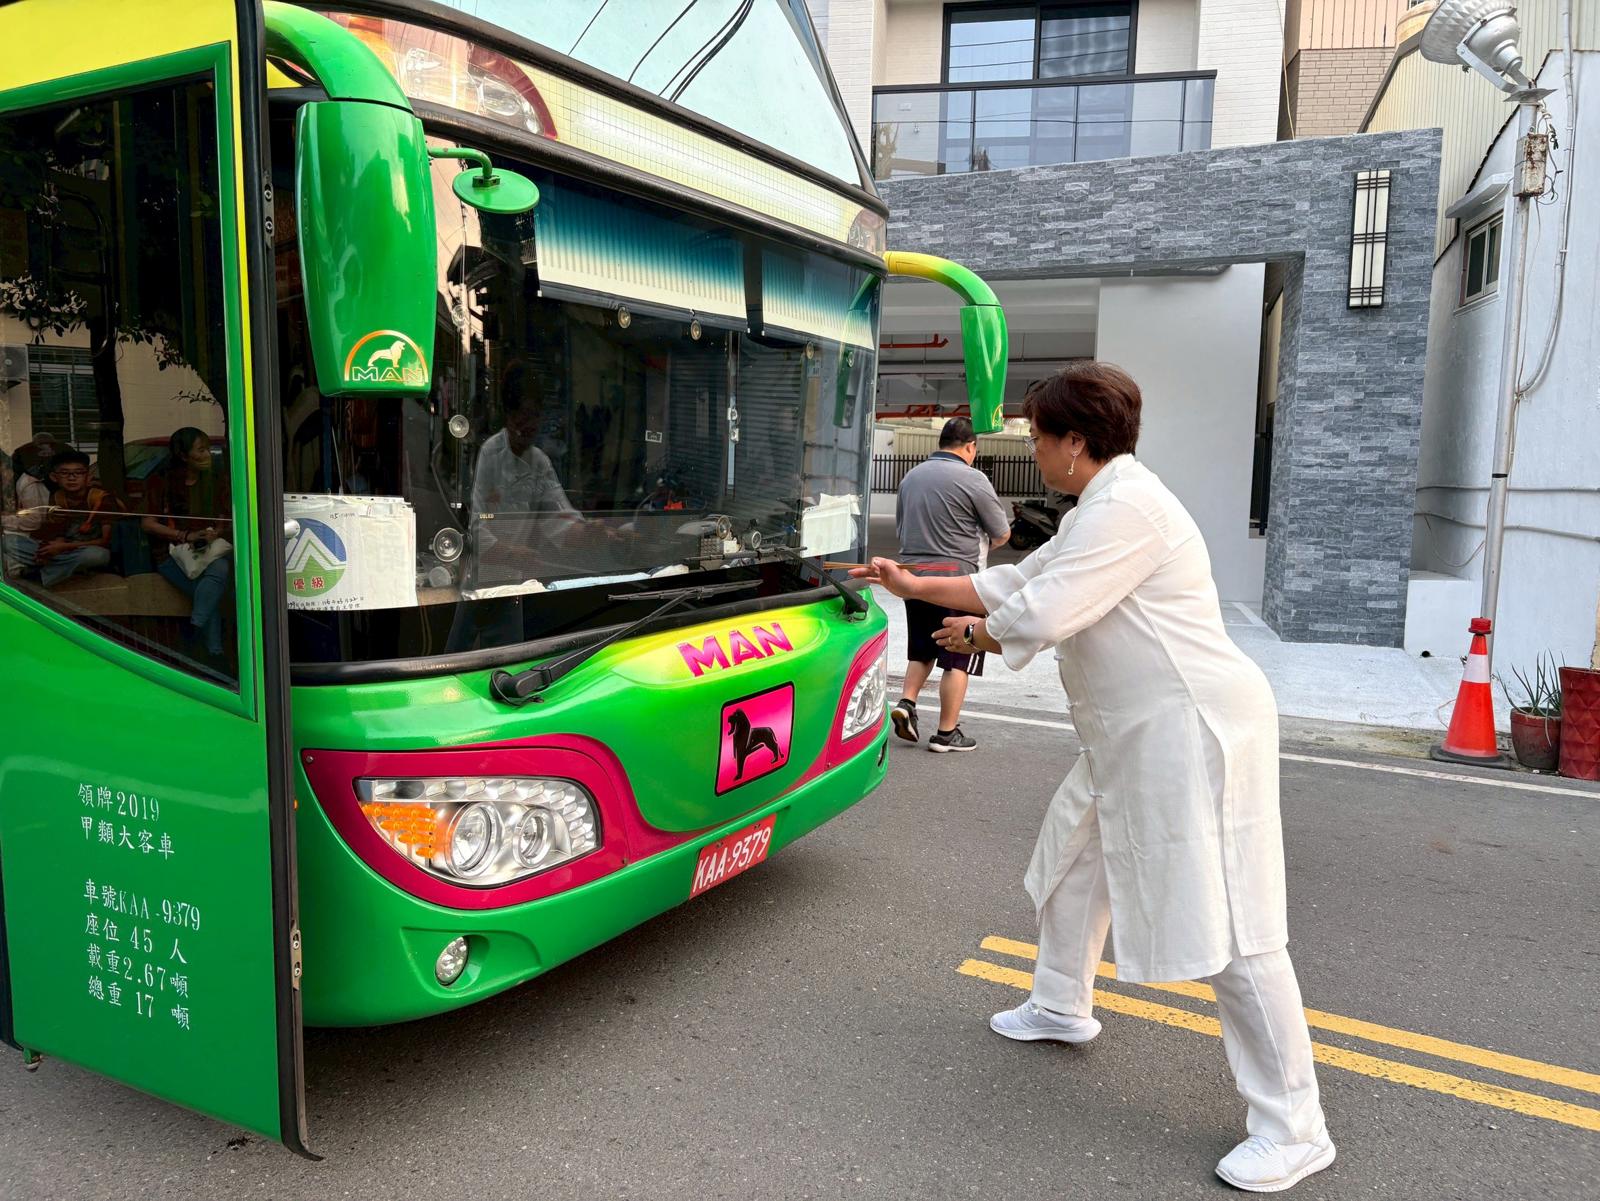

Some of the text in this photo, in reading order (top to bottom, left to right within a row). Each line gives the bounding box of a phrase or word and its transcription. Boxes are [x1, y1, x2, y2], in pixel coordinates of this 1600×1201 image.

[352, 366, 425, 385] MAN
[677, 622, 793, 677] MAN
[78, 783, 160, 822] 領牌2019
[81, 816, 175, 860] 甲類大客車
[692, 826, 771, 893] KAA-9379
[85, 912, 187, 964] 座位 45 人
[88, 975, 190, 1031] 總重 17 噸
